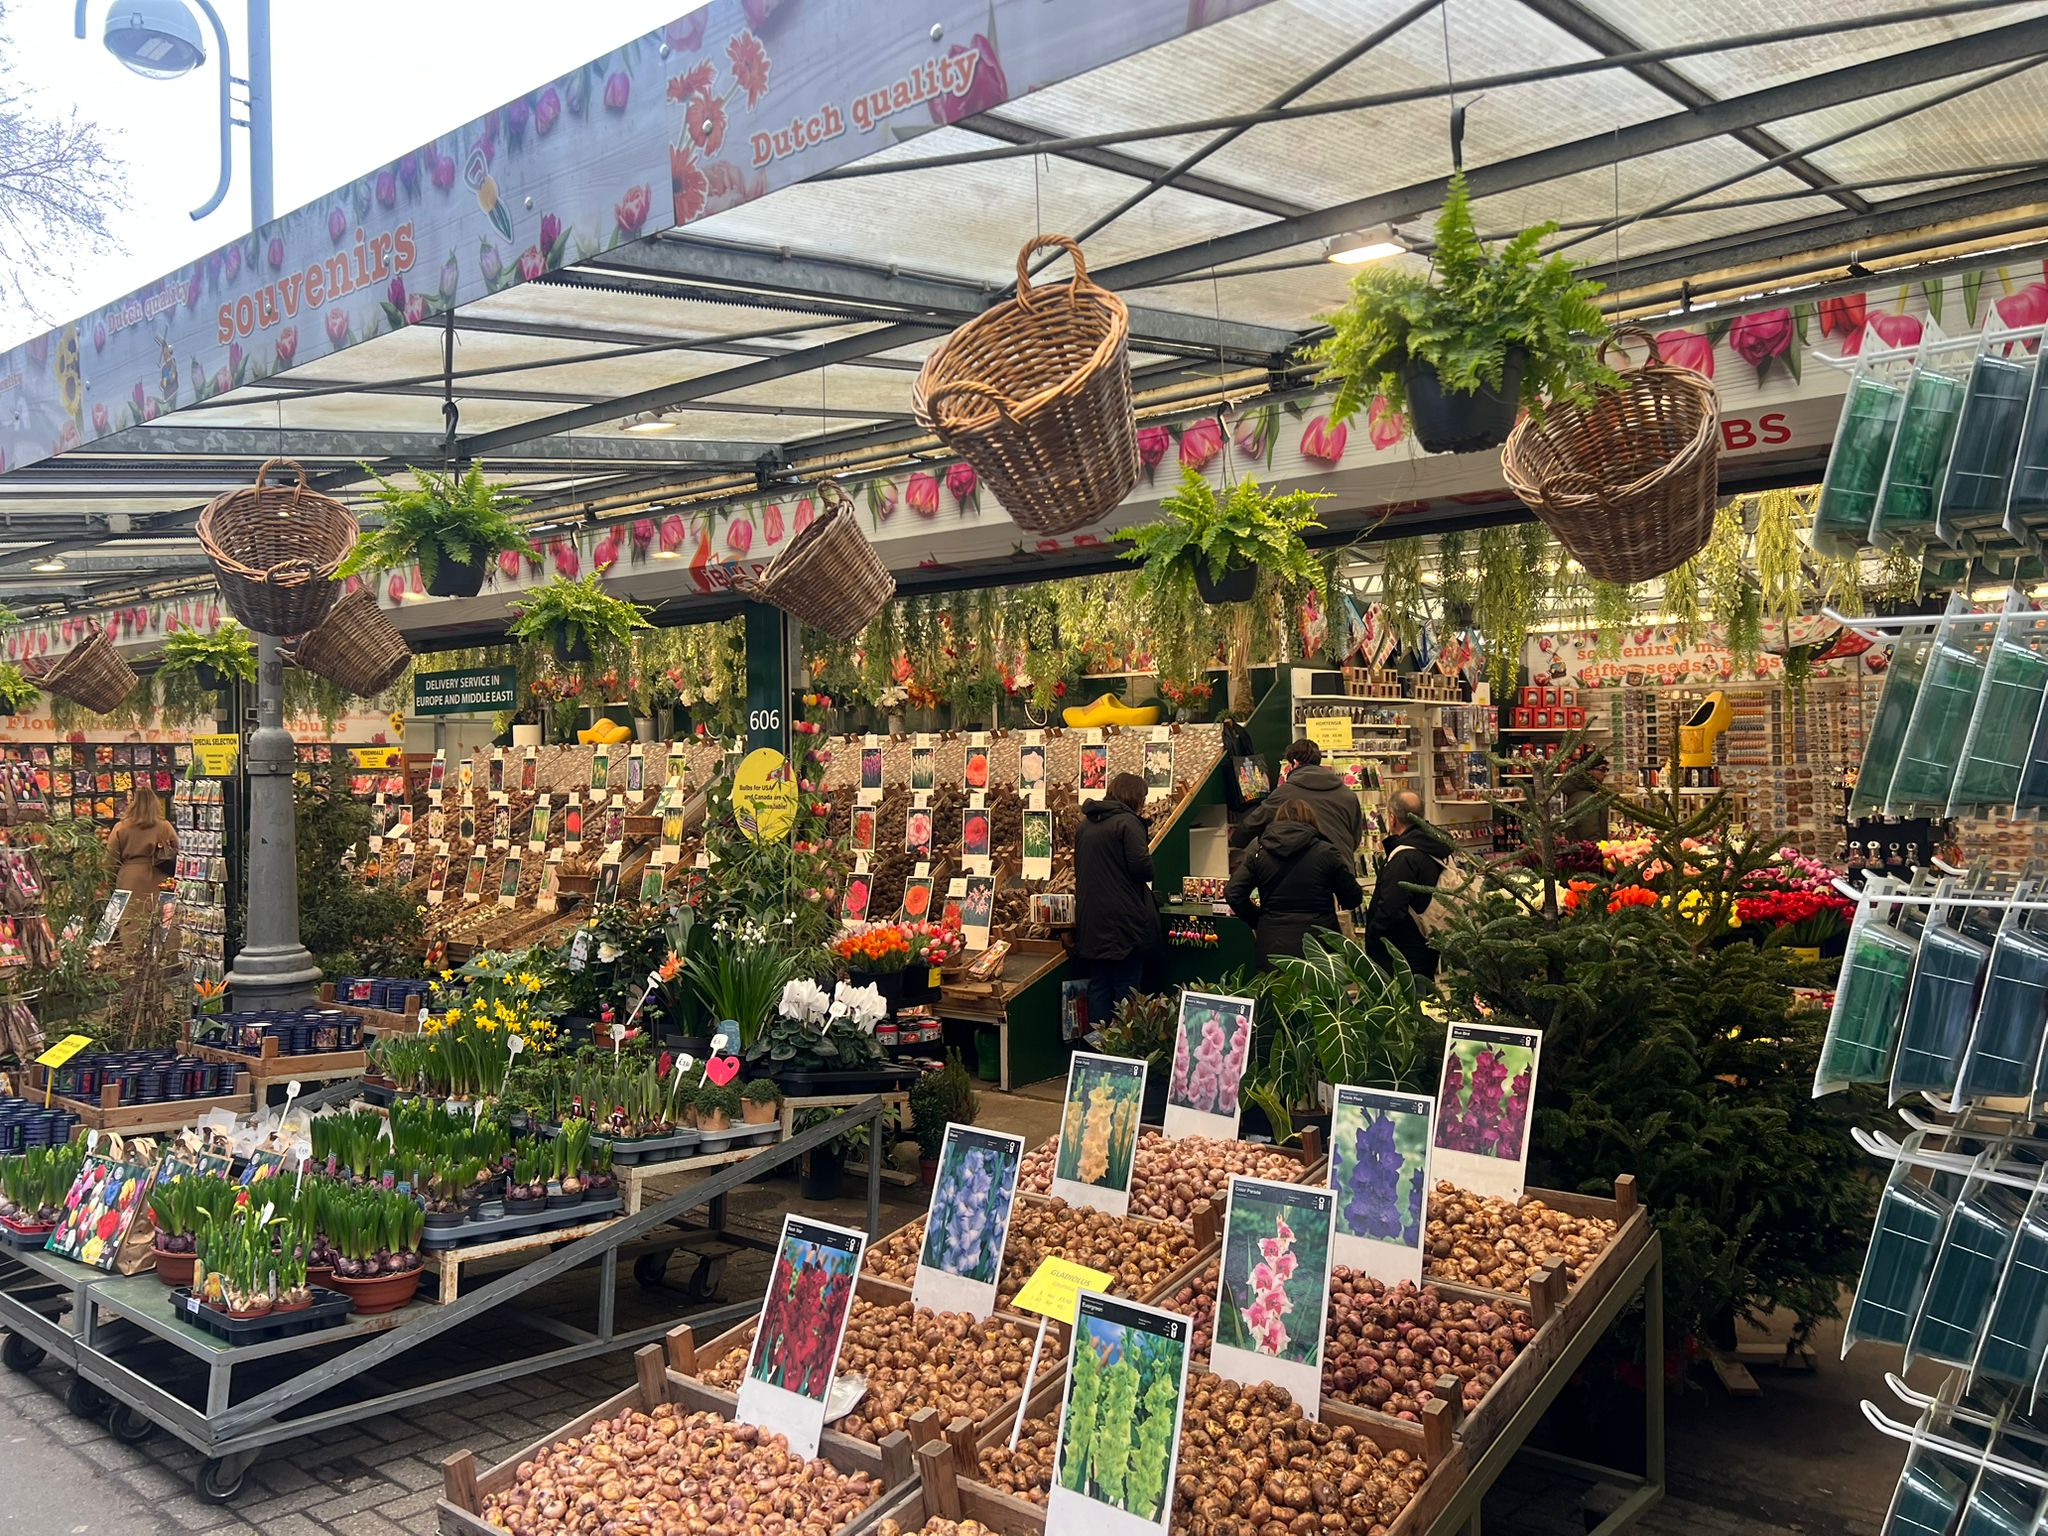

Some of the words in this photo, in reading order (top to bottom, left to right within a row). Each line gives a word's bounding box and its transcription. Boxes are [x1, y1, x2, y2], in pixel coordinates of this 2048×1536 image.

[751, 103, 845, 169] Dutch
[852, 49, 979, 132] quality
[217, 220, 417, 346] souvenirs
[107, 299, 142, 335] Dutch
[144, 280, 190, 321] quality
[1583, 663, 1628, 680] gifts
[1645, 659, 1702, 675] seeds
[425, 678, 459, 691] DELIVERY
[460, 676, 490, 688] SERVICE
[491, 675, 500, 686] IN
[416, 695, 443, 707] EUROPE
[444, 693, 460, 705] AND
[461, 692, 490, 704] MIDDLE
[491, 690, 513, 702] EAST!
[749, 709, 780, 731] 606
[193, 738, 212, 746] SPECIAL
[212, 737, 237, 746] SELECTION
[1234, 1186, 1247, 1194] Color
[1247, 1188, 1262, 1196] Parade
[1050, 1269, 1092, 1287] GLADIOLUS
[1081, 1301, 1104, 1313] Evergreen
